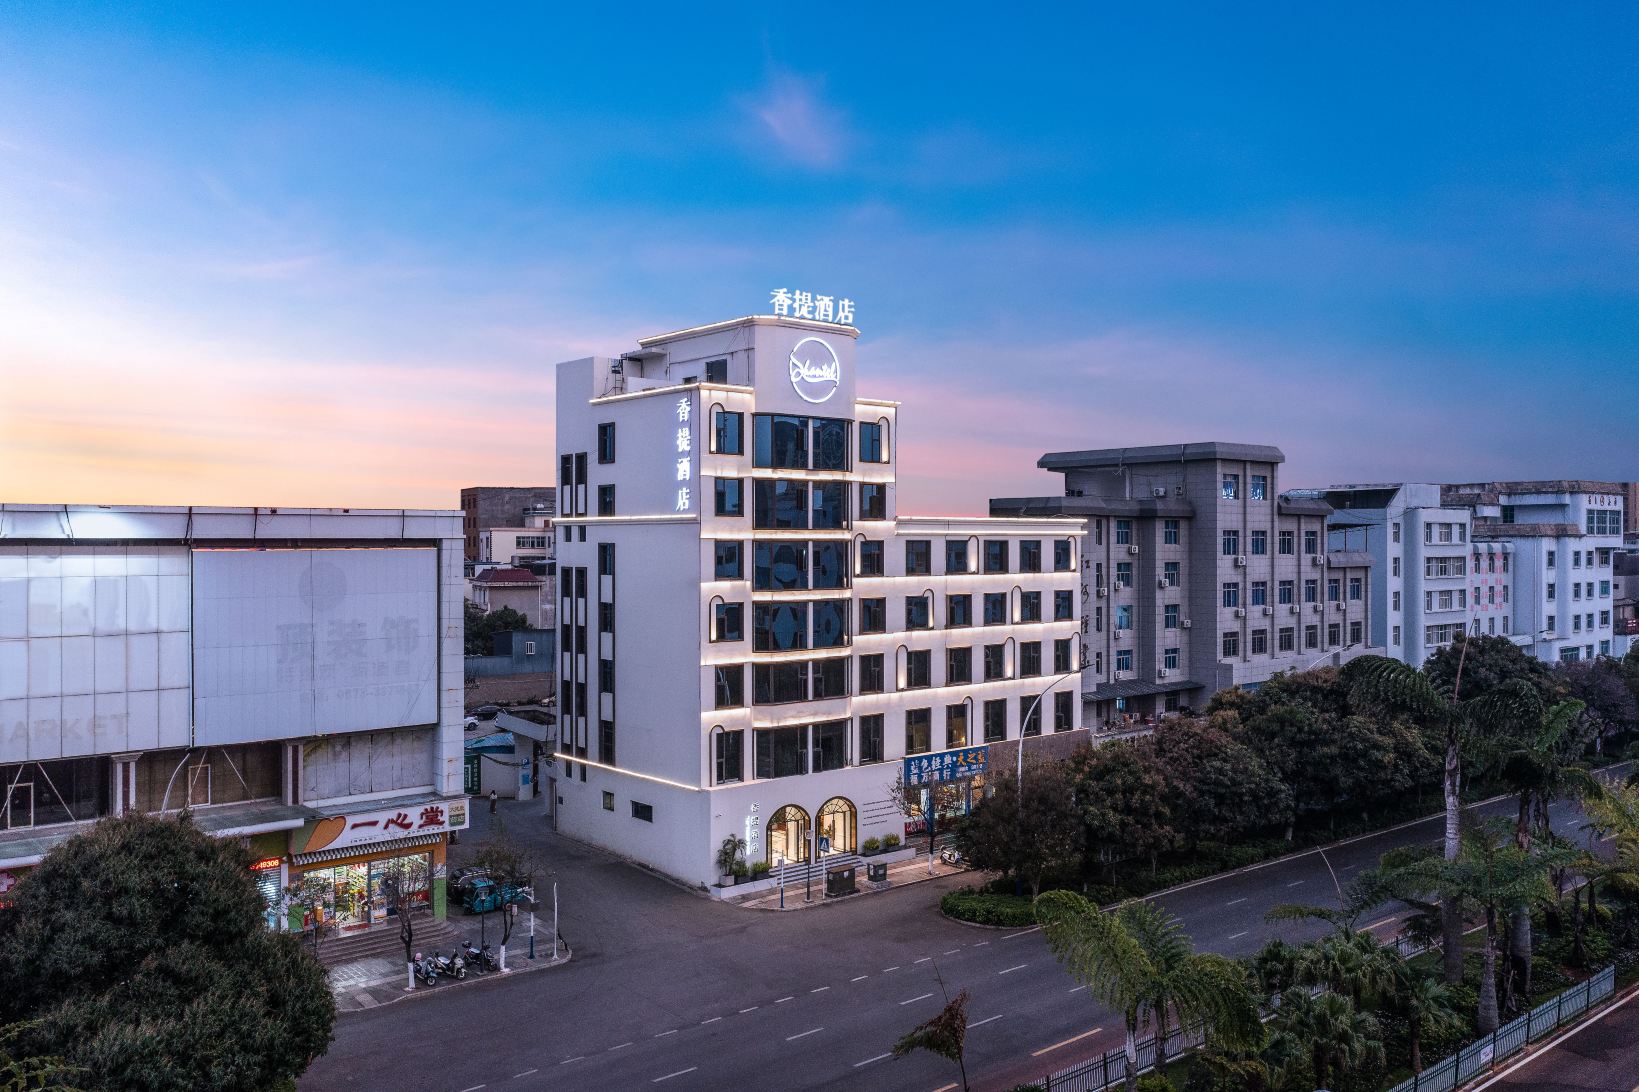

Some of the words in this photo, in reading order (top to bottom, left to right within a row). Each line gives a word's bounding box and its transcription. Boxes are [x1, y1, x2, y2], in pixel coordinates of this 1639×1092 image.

[769, 288, 855, 324] 香提酒店
[676, 397, 691, 511] 香提酒店
[0, 713, 130, 745] ARKET
[350, 805, 445, 831] 一心堂
